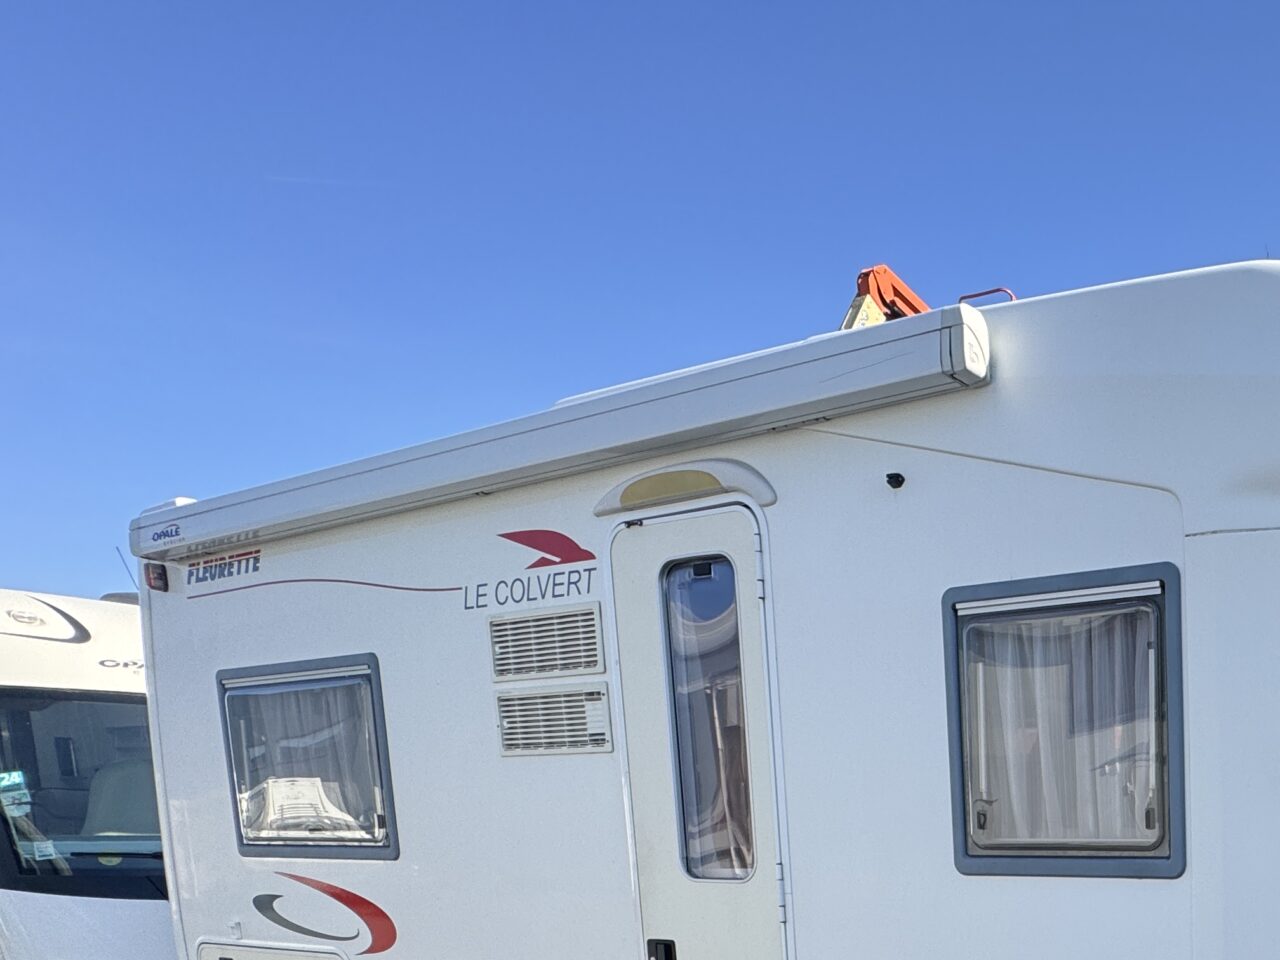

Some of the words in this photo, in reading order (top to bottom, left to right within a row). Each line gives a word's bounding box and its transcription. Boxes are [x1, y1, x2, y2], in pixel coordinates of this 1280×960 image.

[152, 527, 181, 541] OPALE
[186, 549, 261, 585] FLEURETTE
[464, 583, 488, 610] LE
[494, 567, 597, 606] COLVERT
